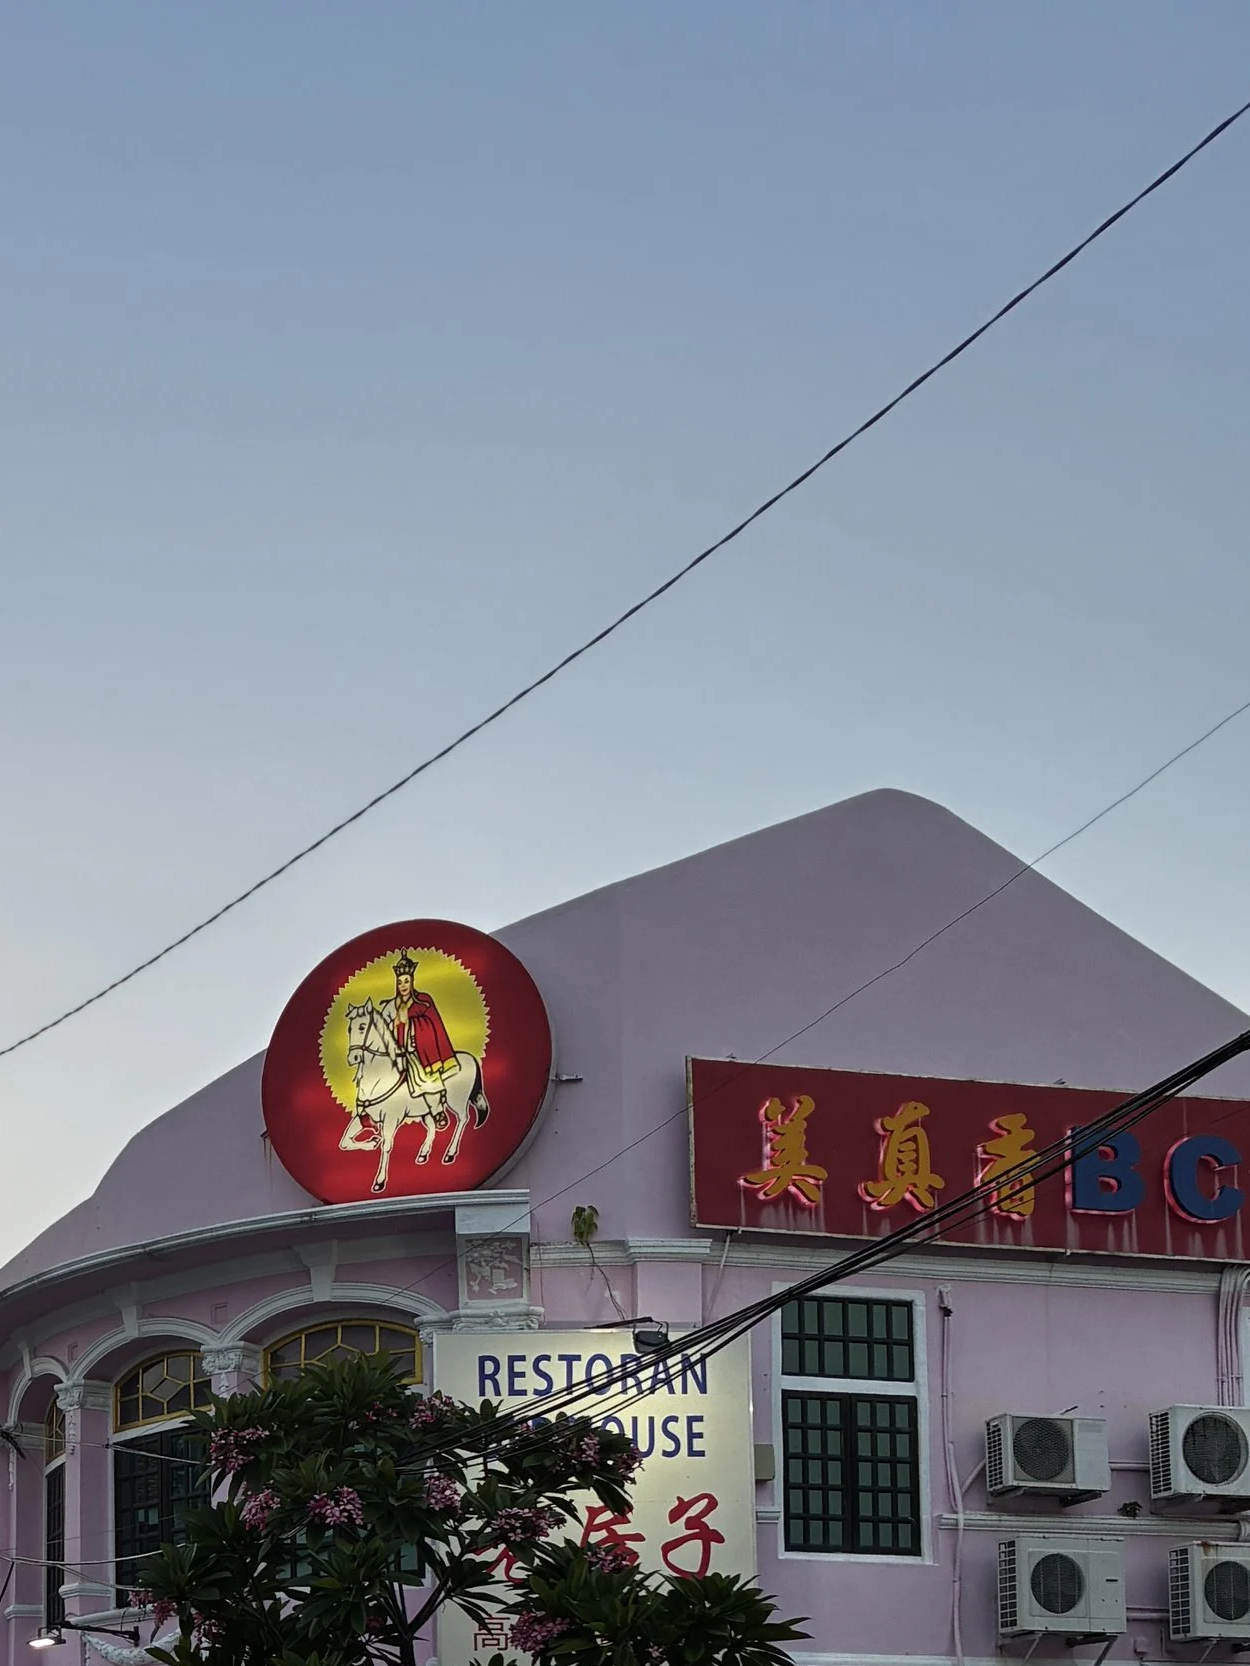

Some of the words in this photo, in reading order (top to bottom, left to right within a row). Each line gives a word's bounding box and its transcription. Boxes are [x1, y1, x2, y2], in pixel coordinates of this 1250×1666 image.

[738, 1095, 1043, 1221] 美真香
[477, 1353, 708, 1398] RESTORAN
